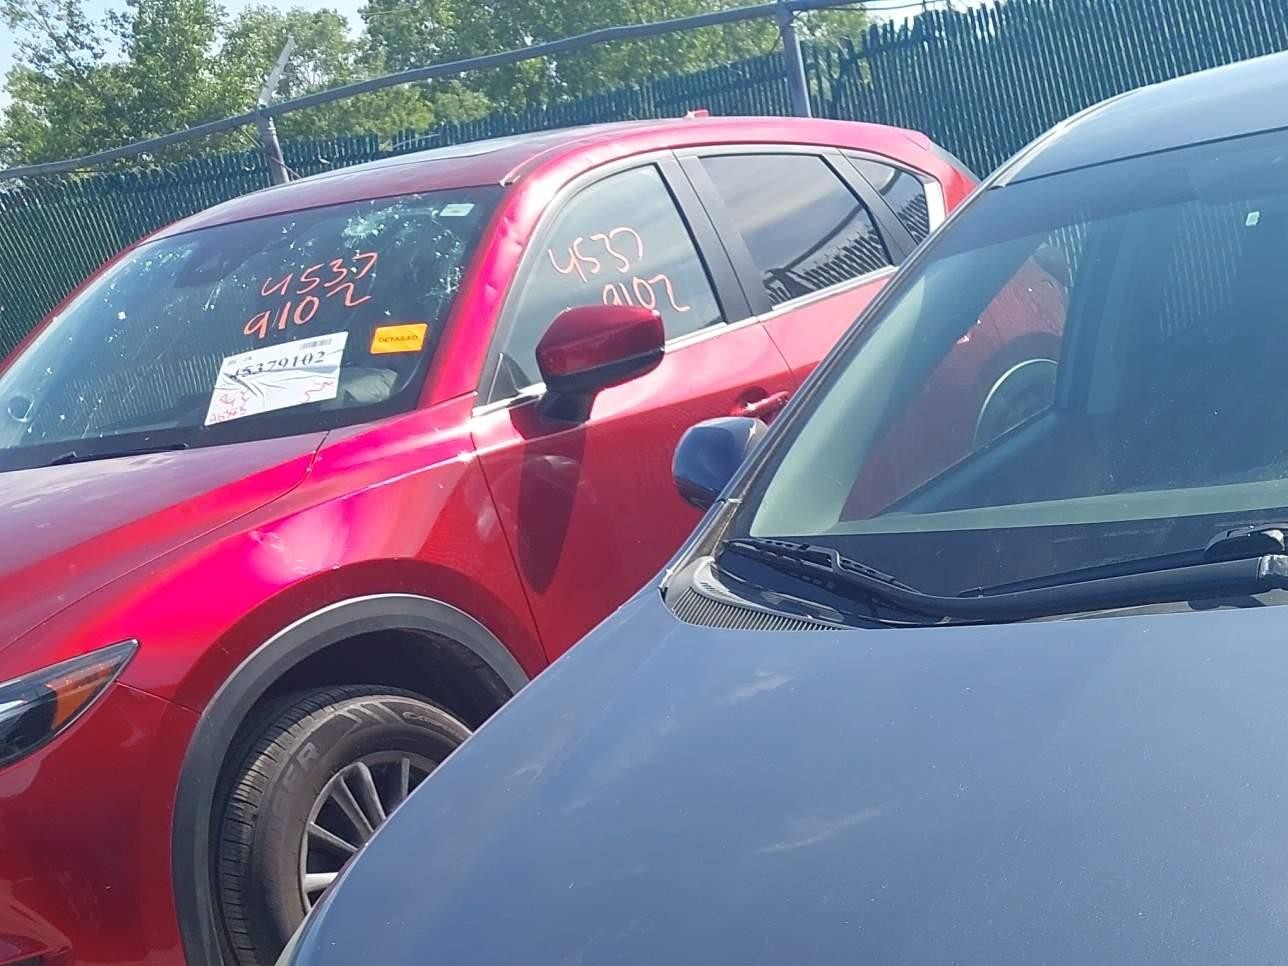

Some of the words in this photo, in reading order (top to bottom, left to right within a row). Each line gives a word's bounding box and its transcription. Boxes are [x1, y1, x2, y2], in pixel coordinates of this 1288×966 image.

[261, 252, 378, 296] 4537
[548, 227, 643, 283] 4537
[243, 282, 372, 338] 9102
[602, 273, 690, 312] 9102
